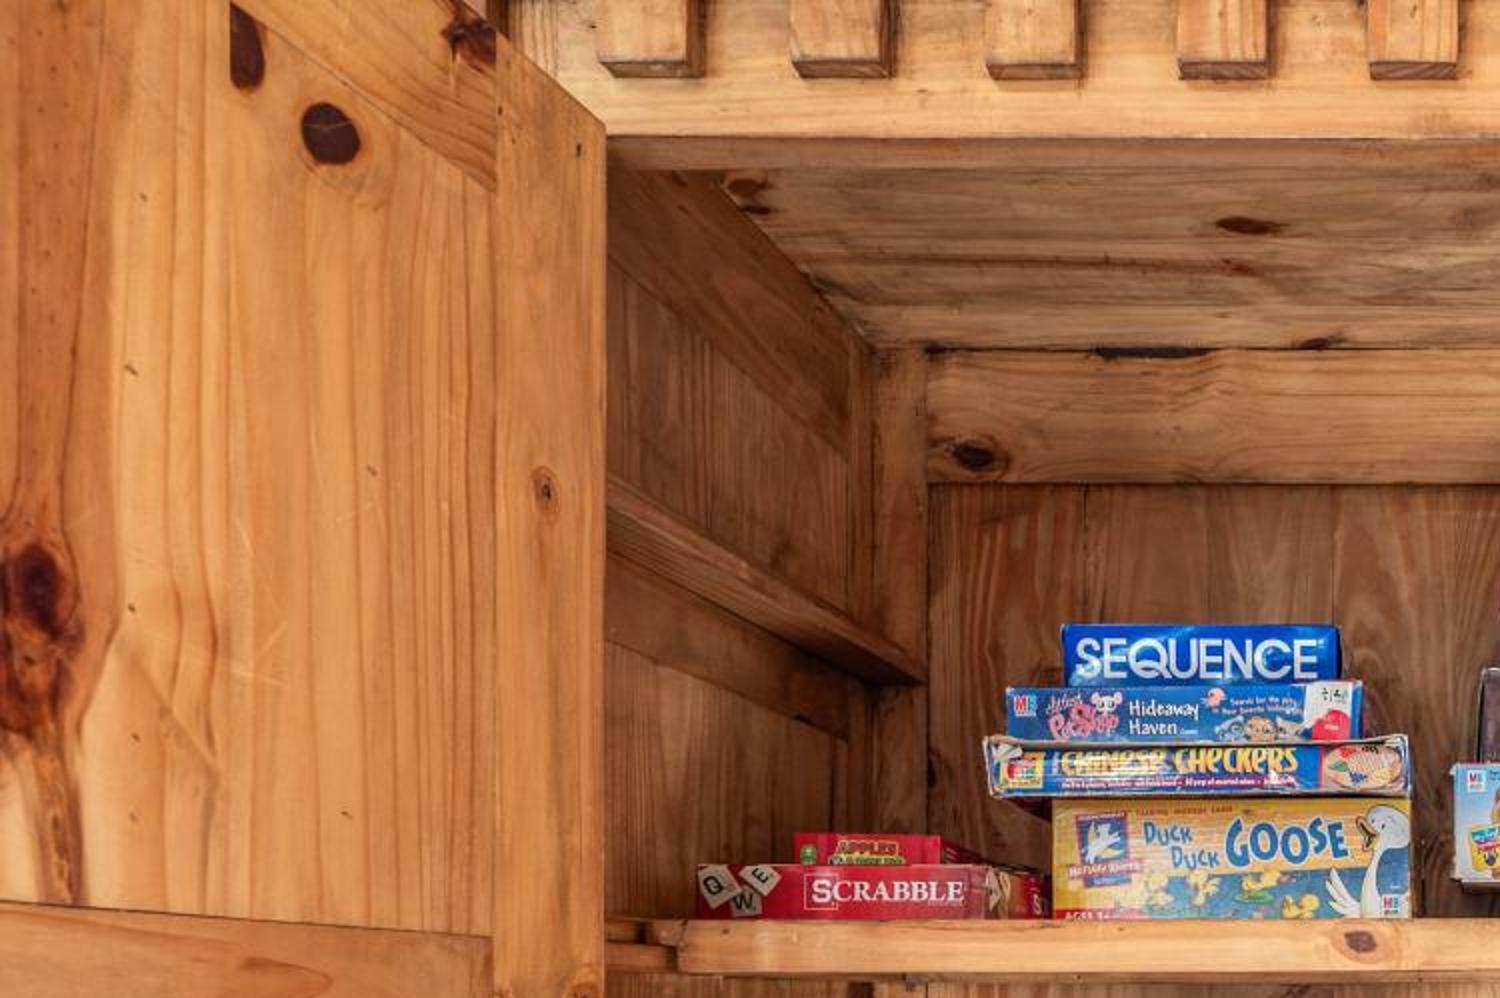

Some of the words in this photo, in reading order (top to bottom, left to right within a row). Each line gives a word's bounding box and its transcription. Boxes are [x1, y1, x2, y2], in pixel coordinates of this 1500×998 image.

[1075, 636, 1319, 680] SEQUENCE
[1129, 699, 1199, 720] Hideaway
[1129, 719, 1178, 735] Haven
[1143, 821, 1193, 846] DUCK
[1171, 846, 1220, 870] DUCK
[1225, 817, 1349, 867] GOOSE
[703, 875, 723, 895] Q
[752, 867, 768, 883] E
[734, 892, 753, 910] W
[812, 879, 964, 903] SCRABBLE
